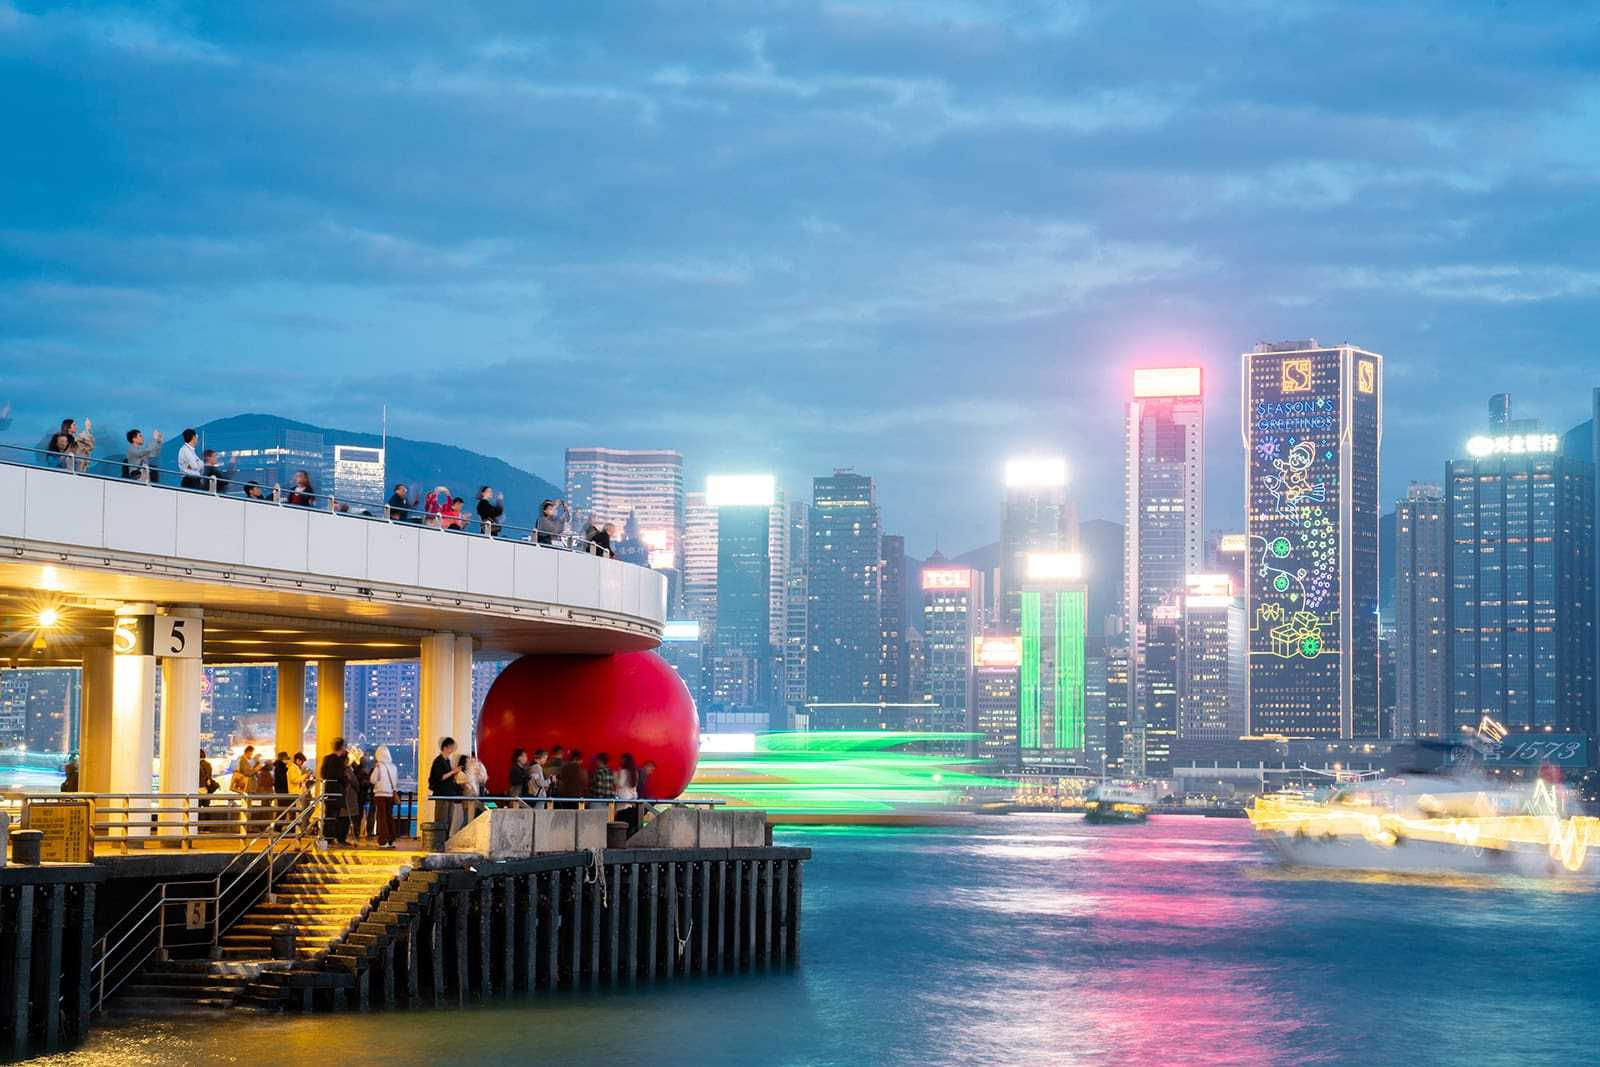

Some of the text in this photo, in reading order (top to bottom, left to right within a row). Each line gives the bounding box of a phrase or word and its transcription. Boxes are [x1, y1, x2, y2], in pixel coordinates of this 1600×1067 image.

[1257, 400, 1333, 416] SEASON'S
[1257, 416, 1333, 431] GREETINGS
[928, 571, 965, 587] TCL
[114, 617, 138, 653] 5
[170, 620, 185, 653] 5
[1507, 741, 1580, 760] 1573
[192, 902, 201, 924] 5
